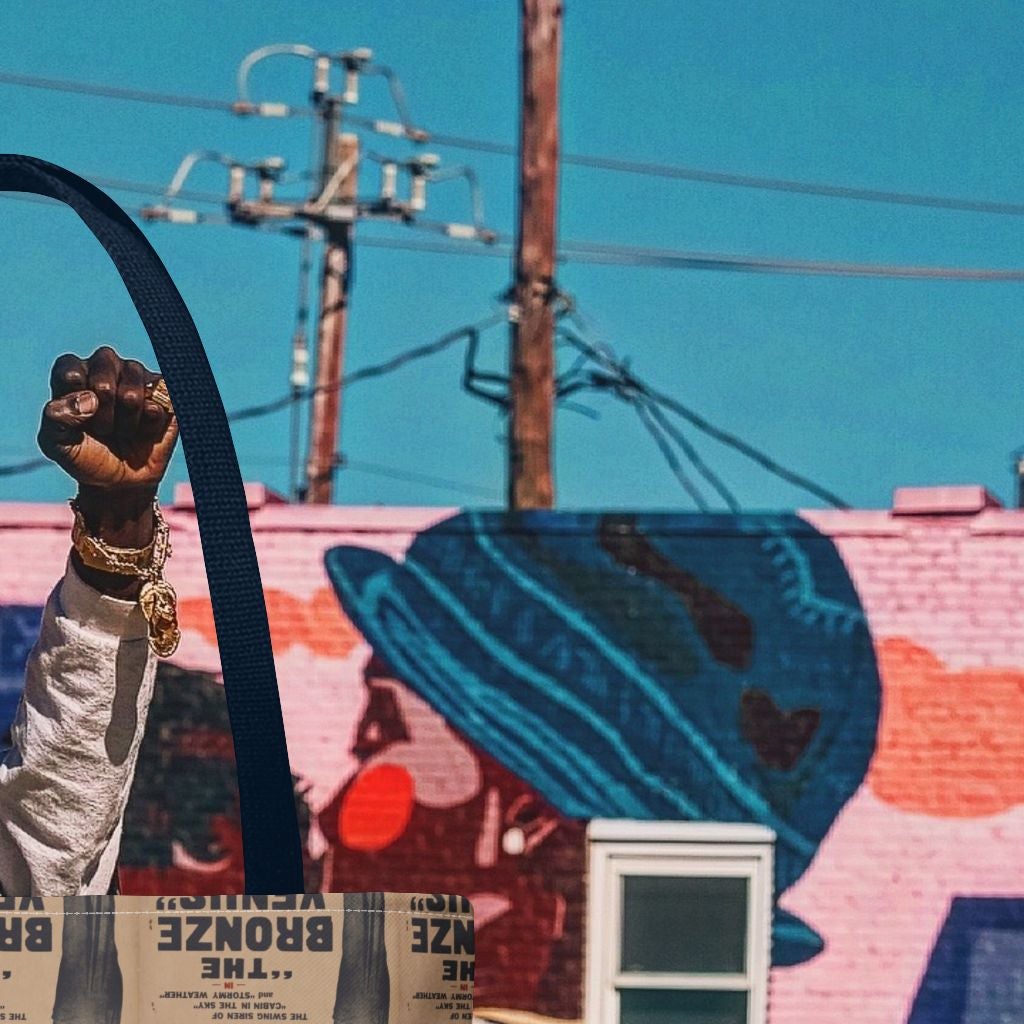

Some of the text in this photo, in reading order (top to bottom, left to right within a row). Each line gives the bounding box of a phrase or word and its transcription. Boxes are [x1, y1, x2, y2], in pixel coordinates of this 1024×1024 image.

[158, 916, 333, 952] BRONZE
[411, 918, 474, 954] NZE
[201, 957, 292, 979] “THE
[213, 991, 255, 999] “STORMY
